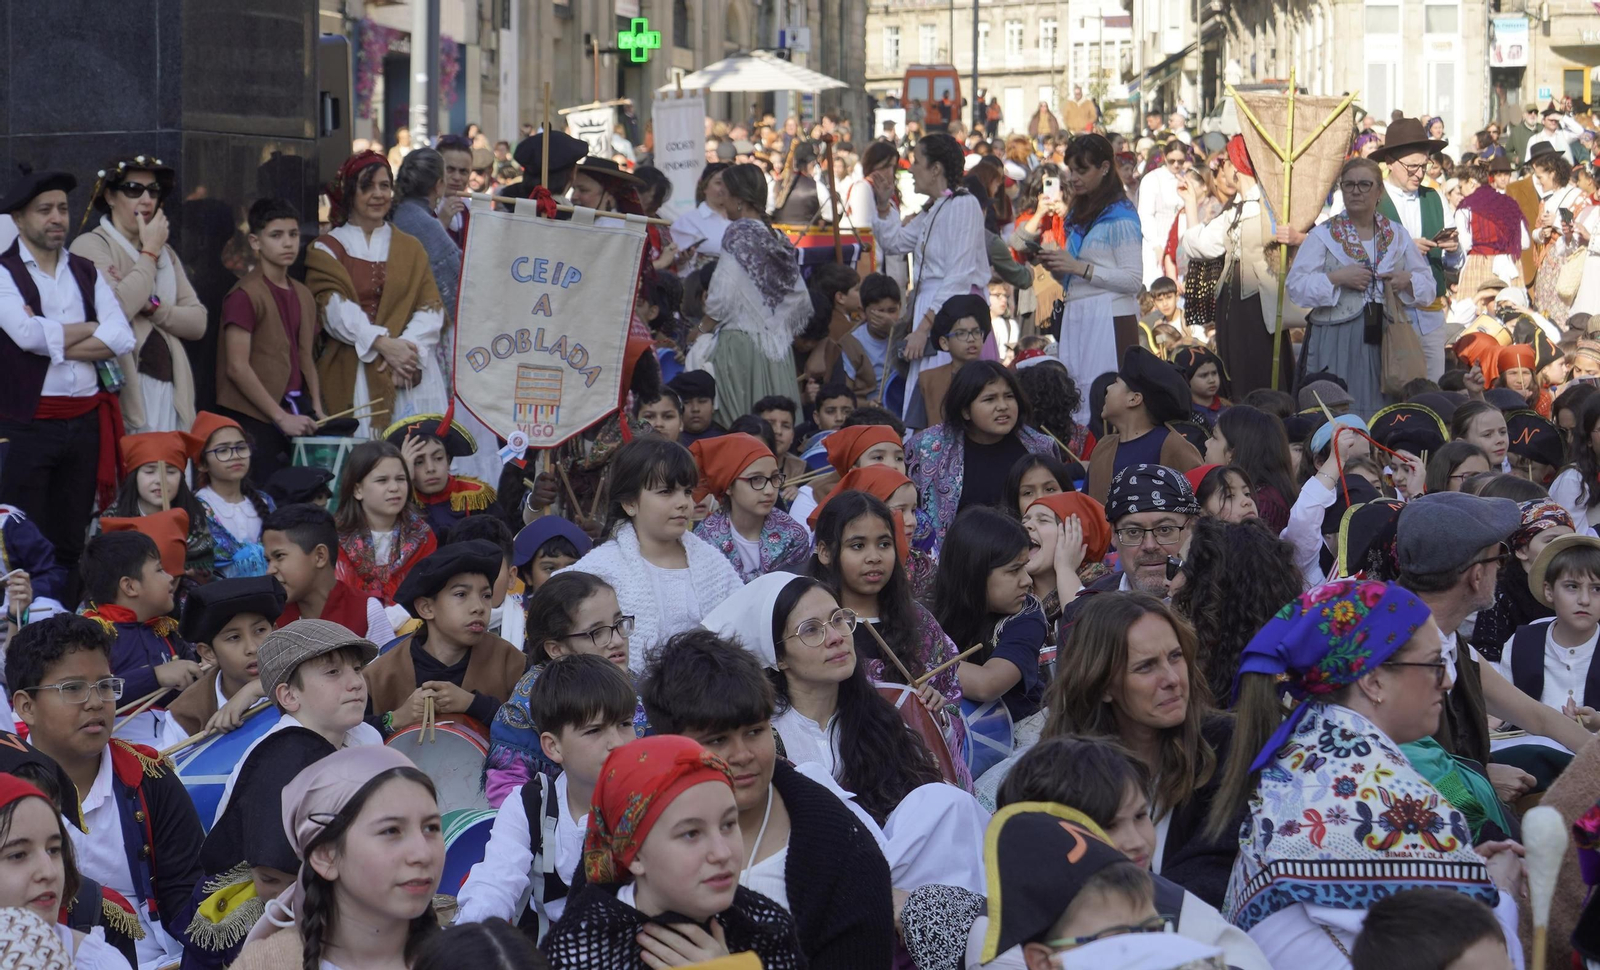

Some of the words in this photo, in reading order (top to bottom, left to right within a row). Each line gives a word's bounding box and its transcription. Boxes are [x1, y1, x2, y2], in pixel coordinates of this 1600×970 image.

[511, 256, 582, 289] CEIP
[531, 293, 552, 317] A
[466, 328, 602, 388] DOBLADA
[1389, 414, 1411, 426] N
[516, 423, 555, 438] VIGO
[1512, 427, 1540, 444] N
